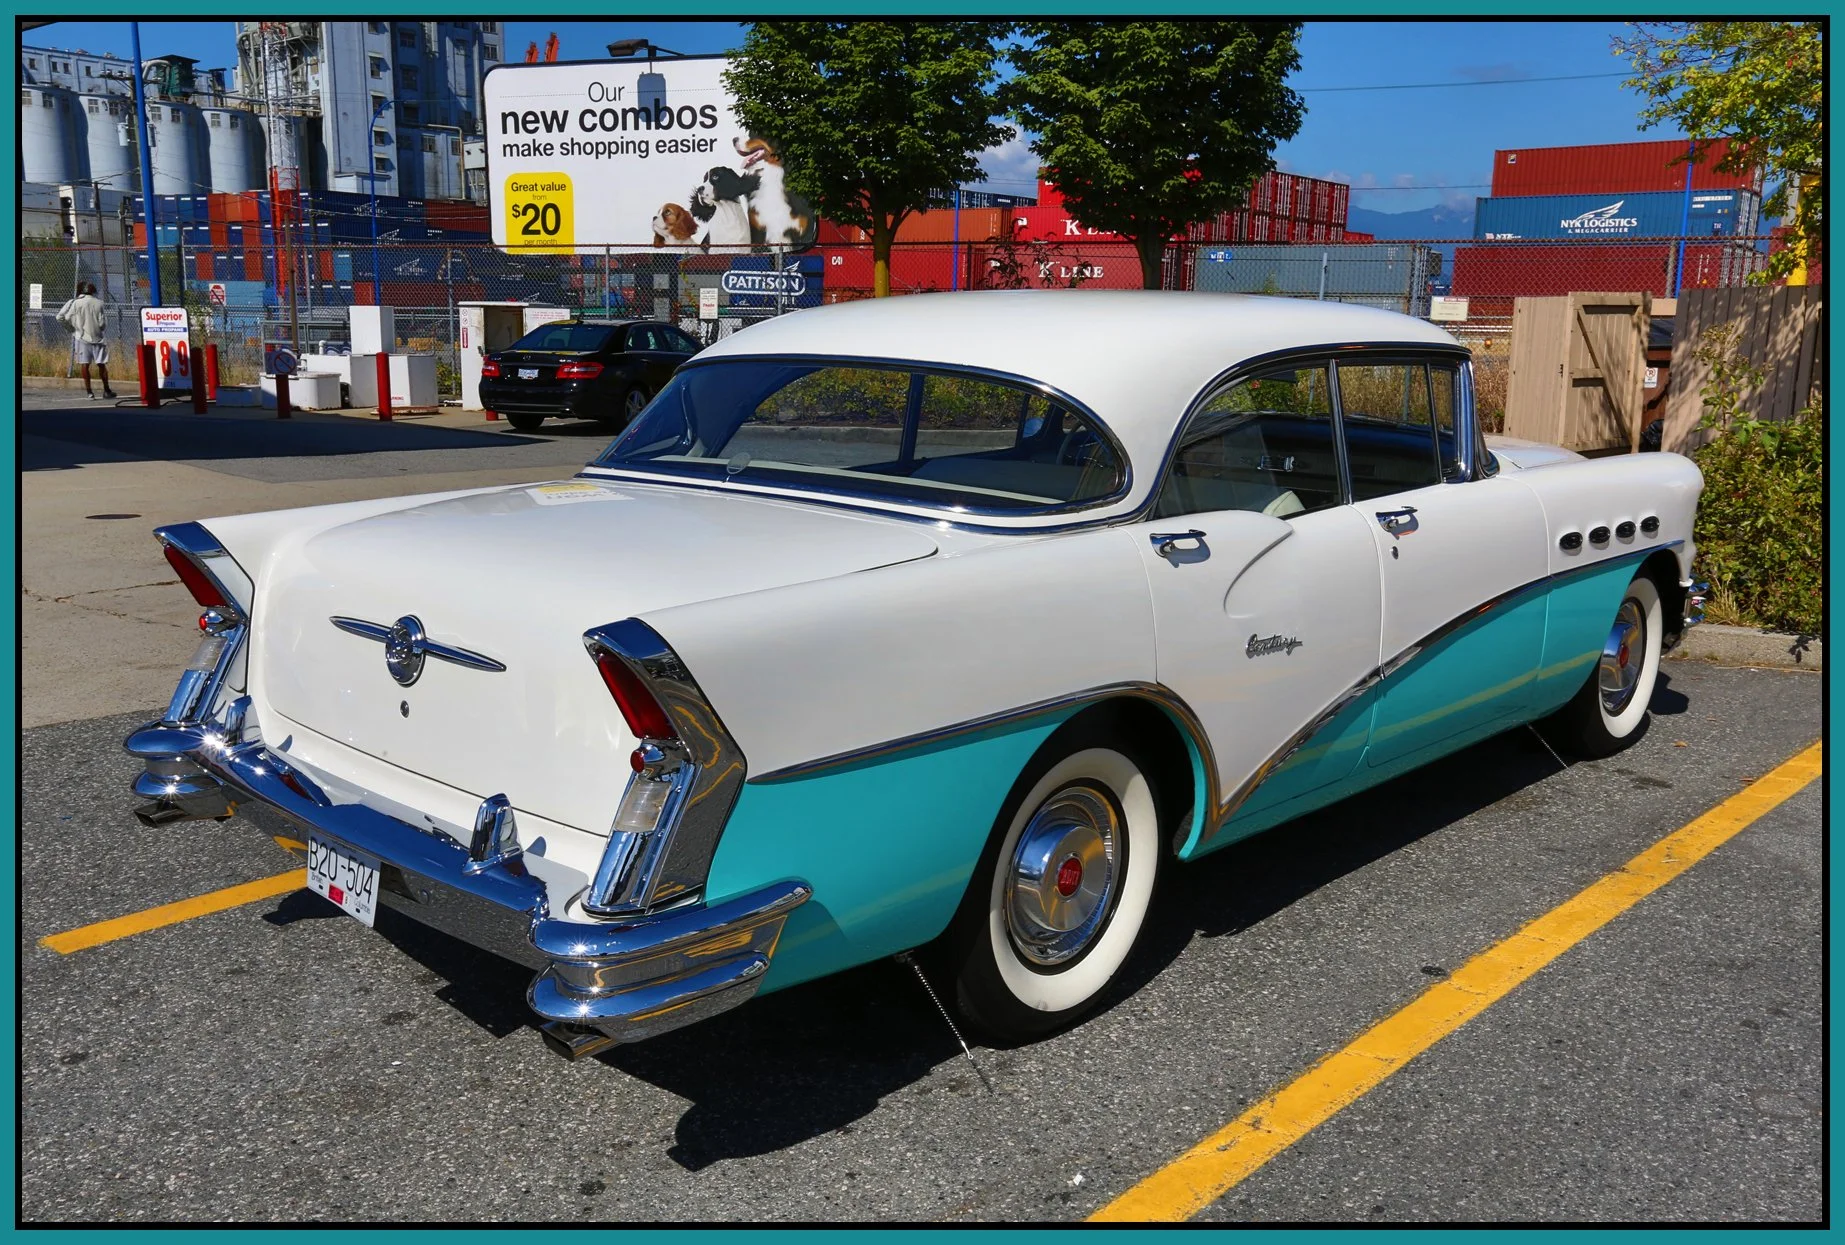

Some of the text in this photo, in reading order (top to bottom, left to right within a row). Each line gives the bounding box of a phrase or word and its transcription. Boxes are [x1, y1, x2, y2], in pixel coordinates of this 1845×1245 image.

[588, 81, 625, 102] Our
[501, 98, 718, 134] new combos
[502, 133, 718, 159] make shopping easier
[511, 182, 567, 192] Great value
[511, 202, 562, 236] $20
[1560, 217, 1638, 228] NYK LOGISTICS
[145, 311, 183, 326] Superior
[1245, 633, 1304, 657] Century
[309, 836, 374, 904] B20-504
